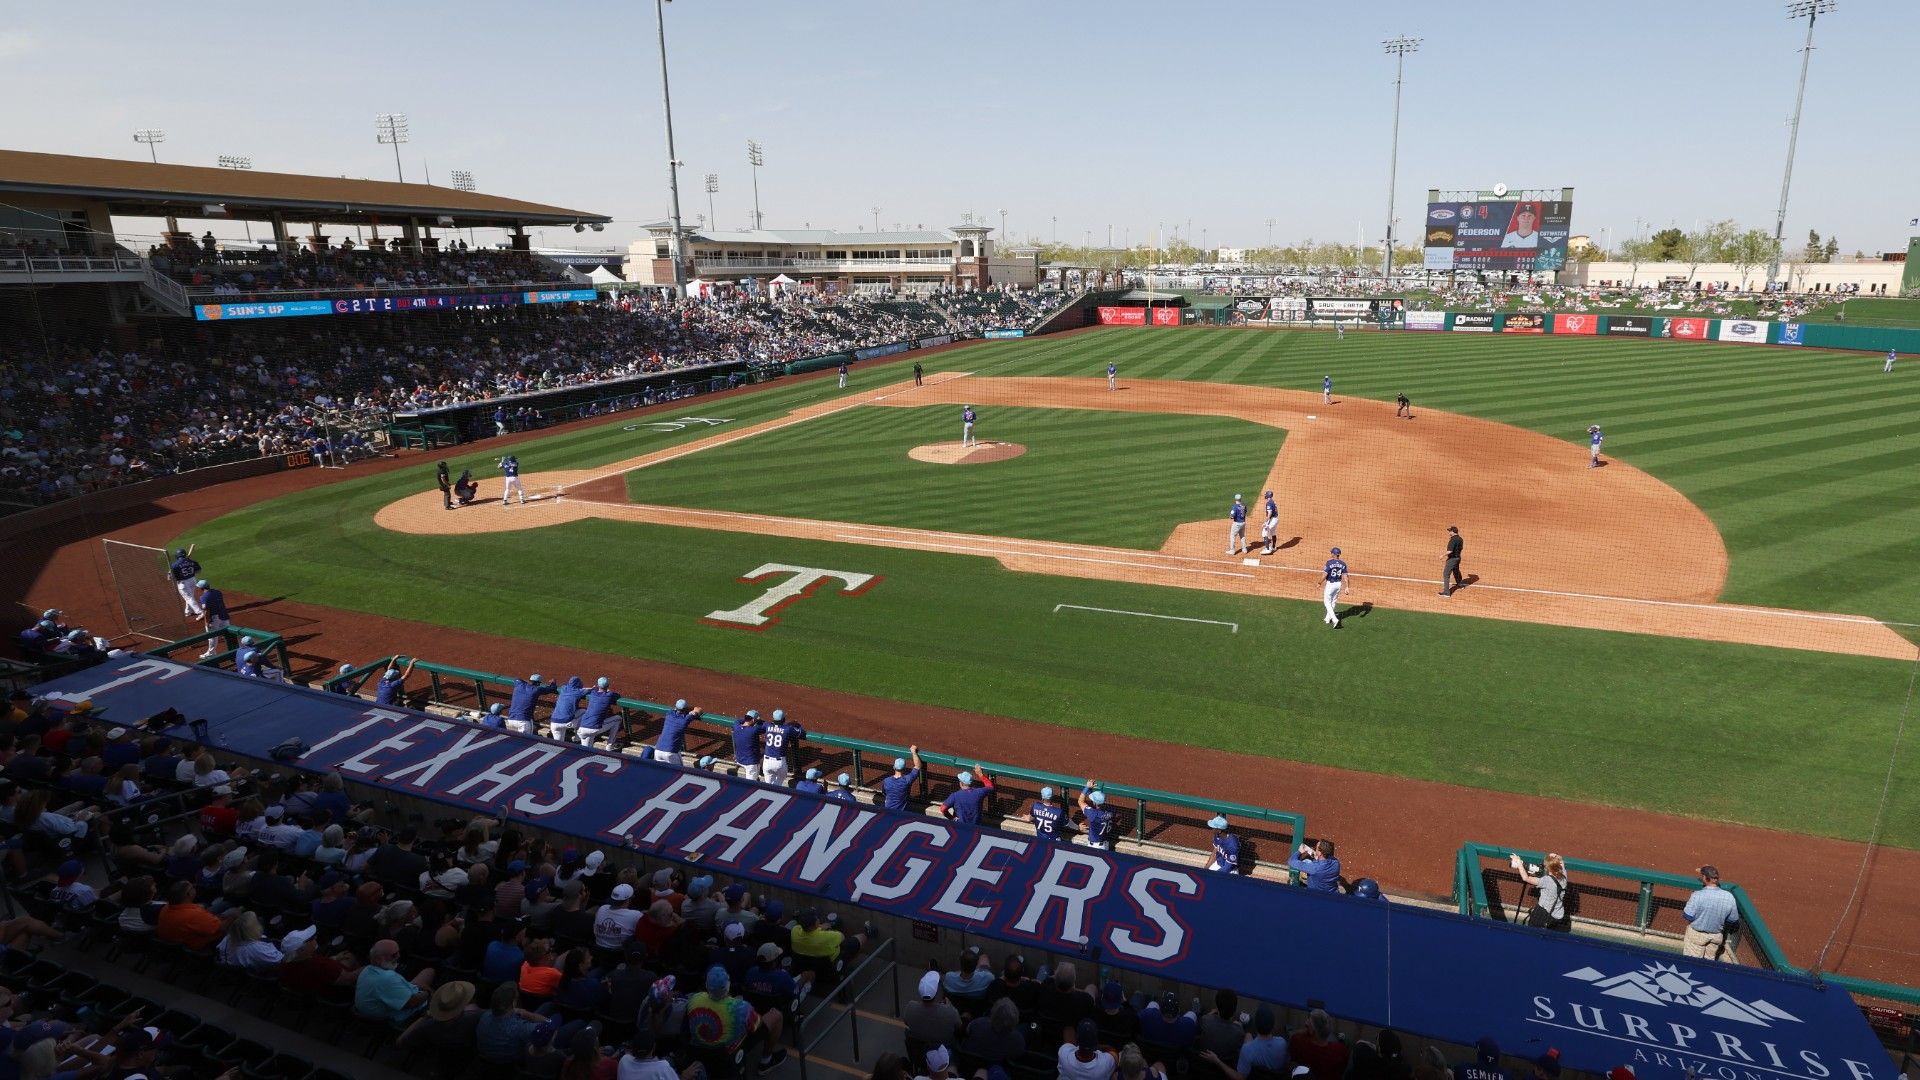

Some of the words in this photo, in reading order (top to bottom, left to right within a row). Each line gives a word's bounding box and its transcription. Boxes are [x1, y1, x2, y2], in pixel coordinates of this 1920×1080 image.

[1457, 228, 1500, 236] PEDERSON
[541, 292, 561, 301] SUN'S
[562, 292, 572, 300] UP
[227, 306, 265, 316] SUN'S
[268, 305, 285, 315] UP
[352, 299, 361, 312] 2
[384, 298, 392, 310] 2
[412, 298, 427, 308] 4TH
[437, 297, 443, 306] 4
[698, 562, 886, 633] T
[766, 733, 783, 748] 38
[1033, 808, 1058, 821] FREEMAN
[1036, 816, 1053, 833] 75
[297, 707, 624, 816] TEXAS
[607, 773, 1198, 962] RANGERS
[1870, 1005, 1897, 1015] CAUTION
[1532, 995, 1880, 1080] SURPRISE
[1634, 1048, 1778, 1080] ARIZON
[1466, 1068, 1504, 1080] SEMIEN
